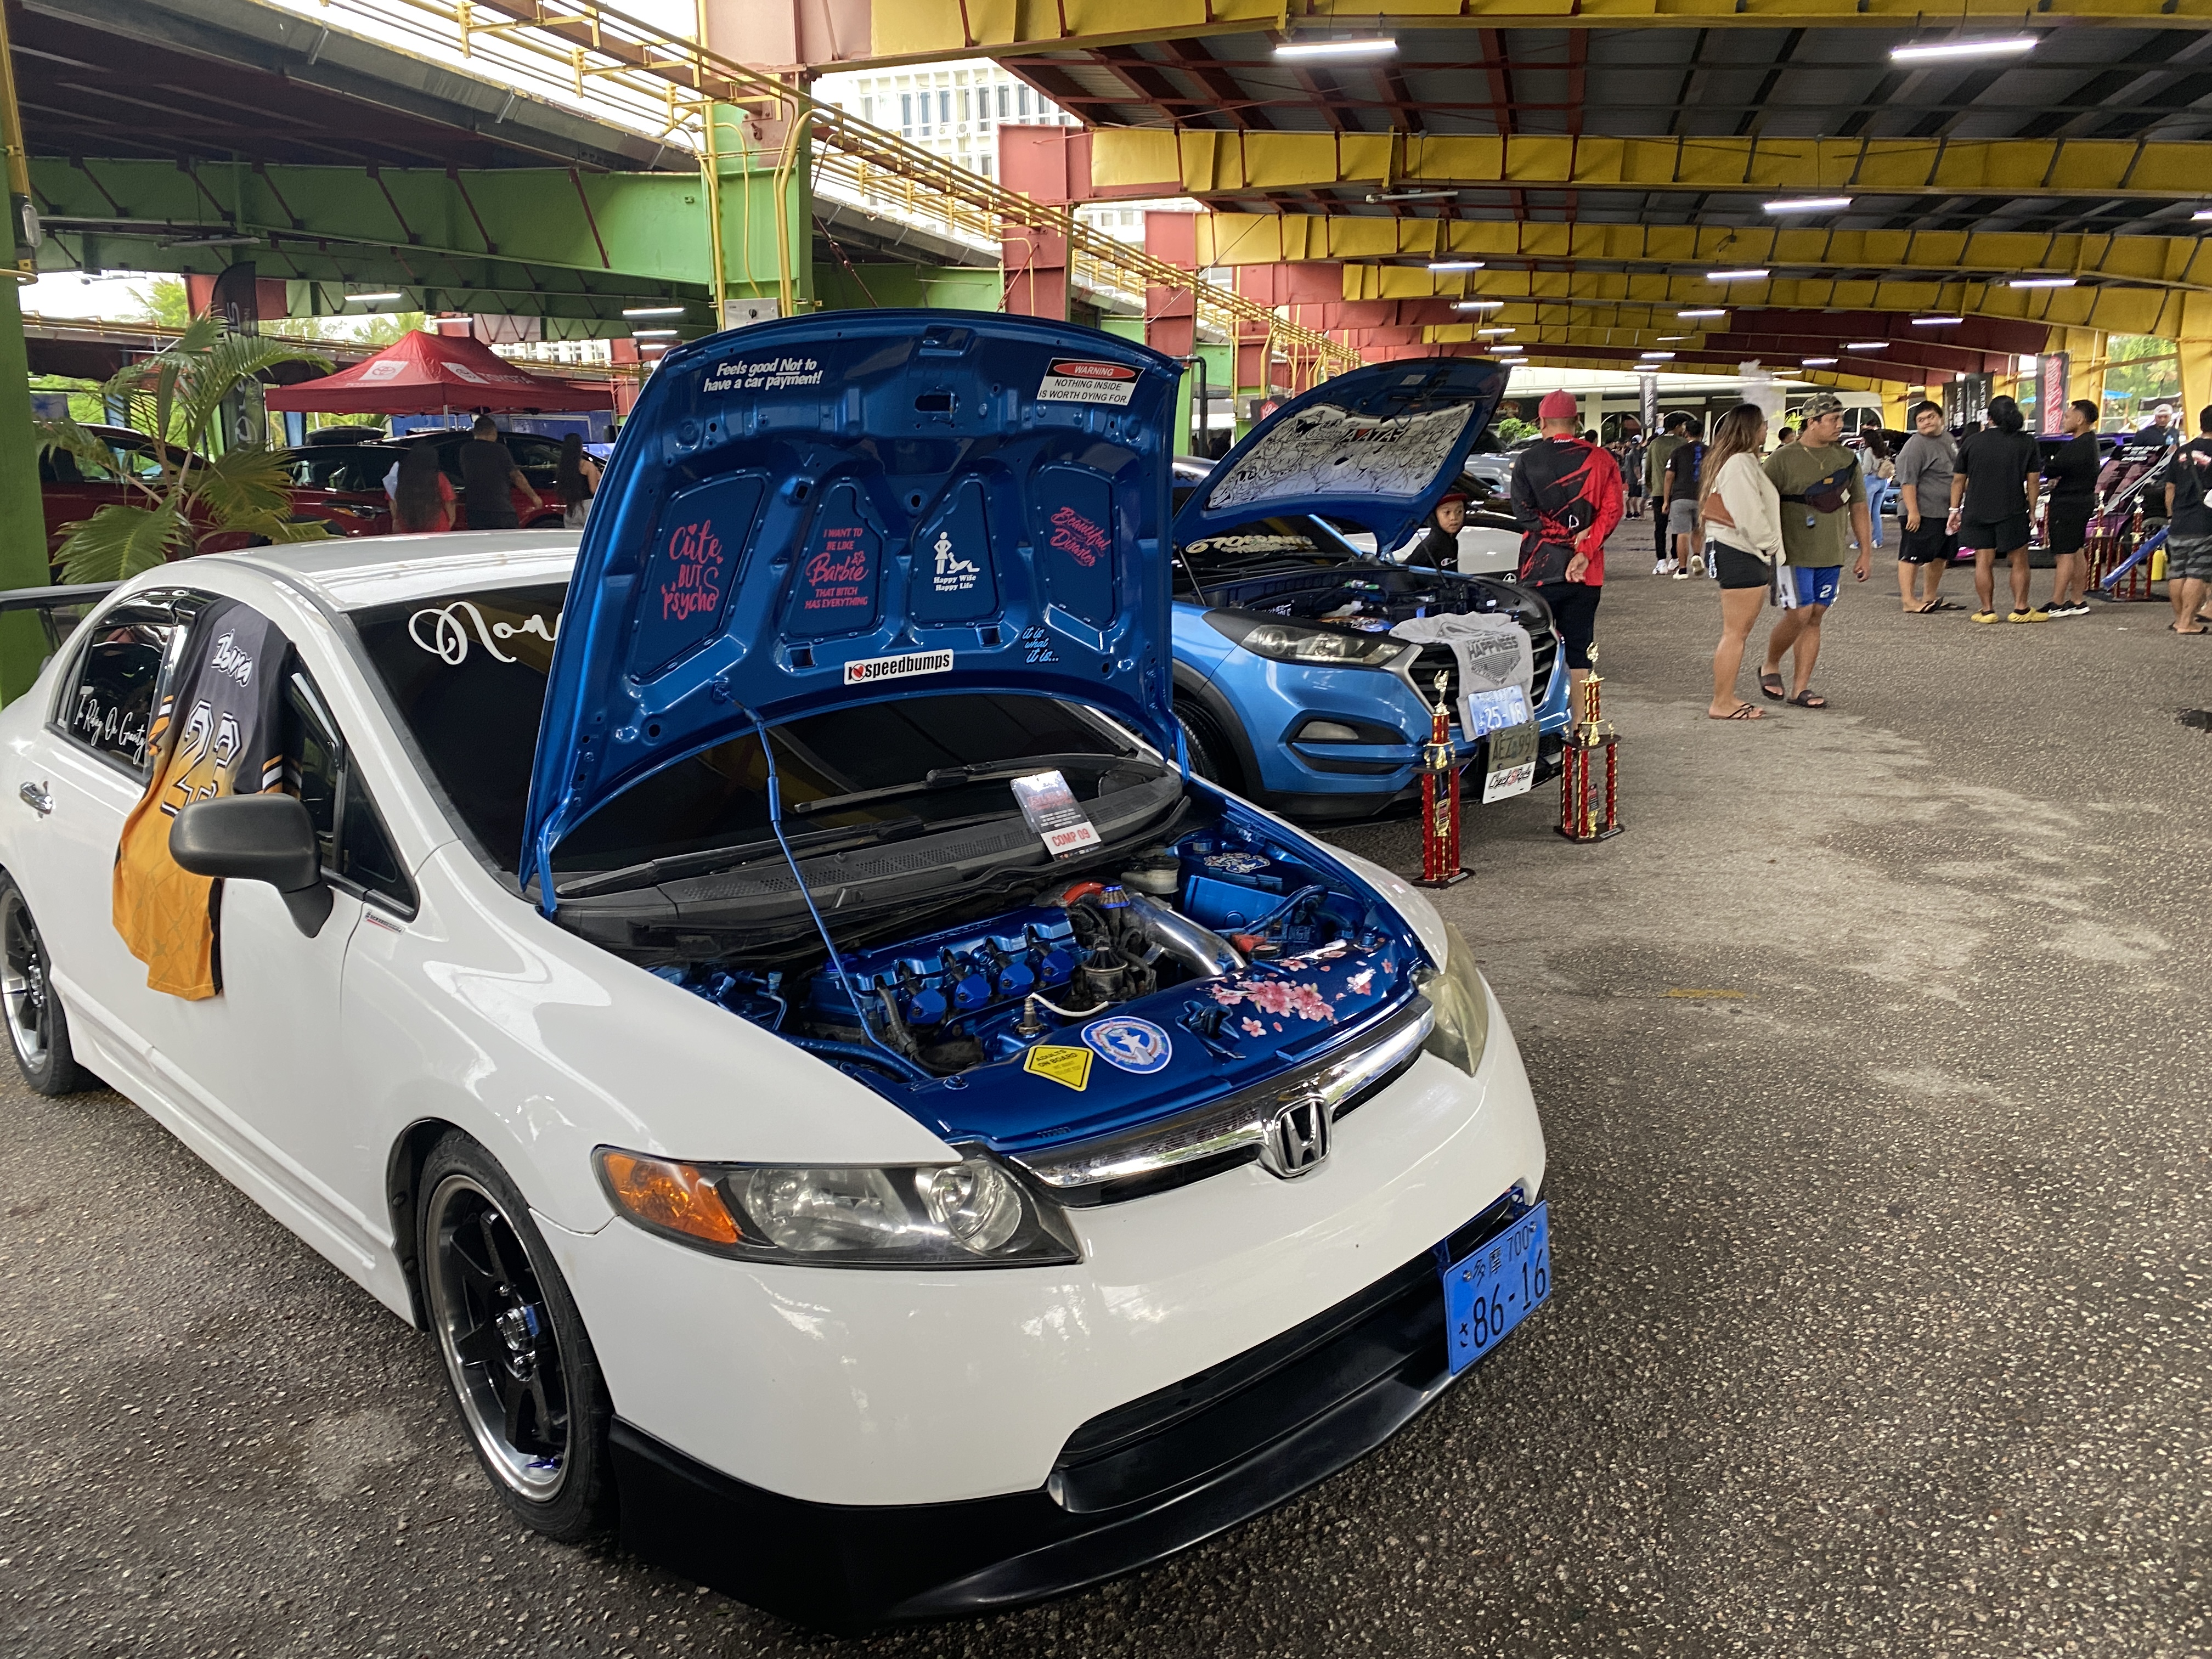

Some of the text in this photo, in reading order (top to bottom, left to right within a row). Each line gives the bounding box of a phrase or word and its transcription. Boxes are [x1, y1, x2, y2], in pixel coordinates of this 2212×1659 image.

[716, 358, 817, 377] Feels good Not to
[1074, 365, 1114, 376] WARNING
[477, 372, 535, 384] TOYOTA
[703, 370, 823, 392] have a car payment!
[1054, 379, 1122, 391] NOTHING INSIDE
[1049, 391, 1080, 399] WORTH
[1081, 392, 1107, 402] DYING
[1109, 394, 1127, 403] FOR.
[823, 528, 863, 538] I WANT TO
[1051, 506, 1111, 551] Beautiful
[669, 520, 723, 564] Cute
[826, 540, 855, 551] BE LIKE
[1050, 528, 1096, 567] Disaster
[678, 564, 703, 588] BUT
[805, 552, 869, 586] Barbie
[815, 586, 858, 597] THAT BITCH
[1819, 584, 1832, 598] 2
[804, 596, 868, 610] HAS EVERYTHING
[1022, 627, 1045, 639] it is
[1024, 637, 1049, 648] what
[1026, 648, 1040, 663] it
[865, 654, 950, 678] speedbumps
[1052, 828, 1091, 847] COMP 09
[1050, 1053, 1078, 1064] BOARD
[1506, 1226, 1530, 1262] 700
[1473, 1248, 1546, 1348] 86-16
